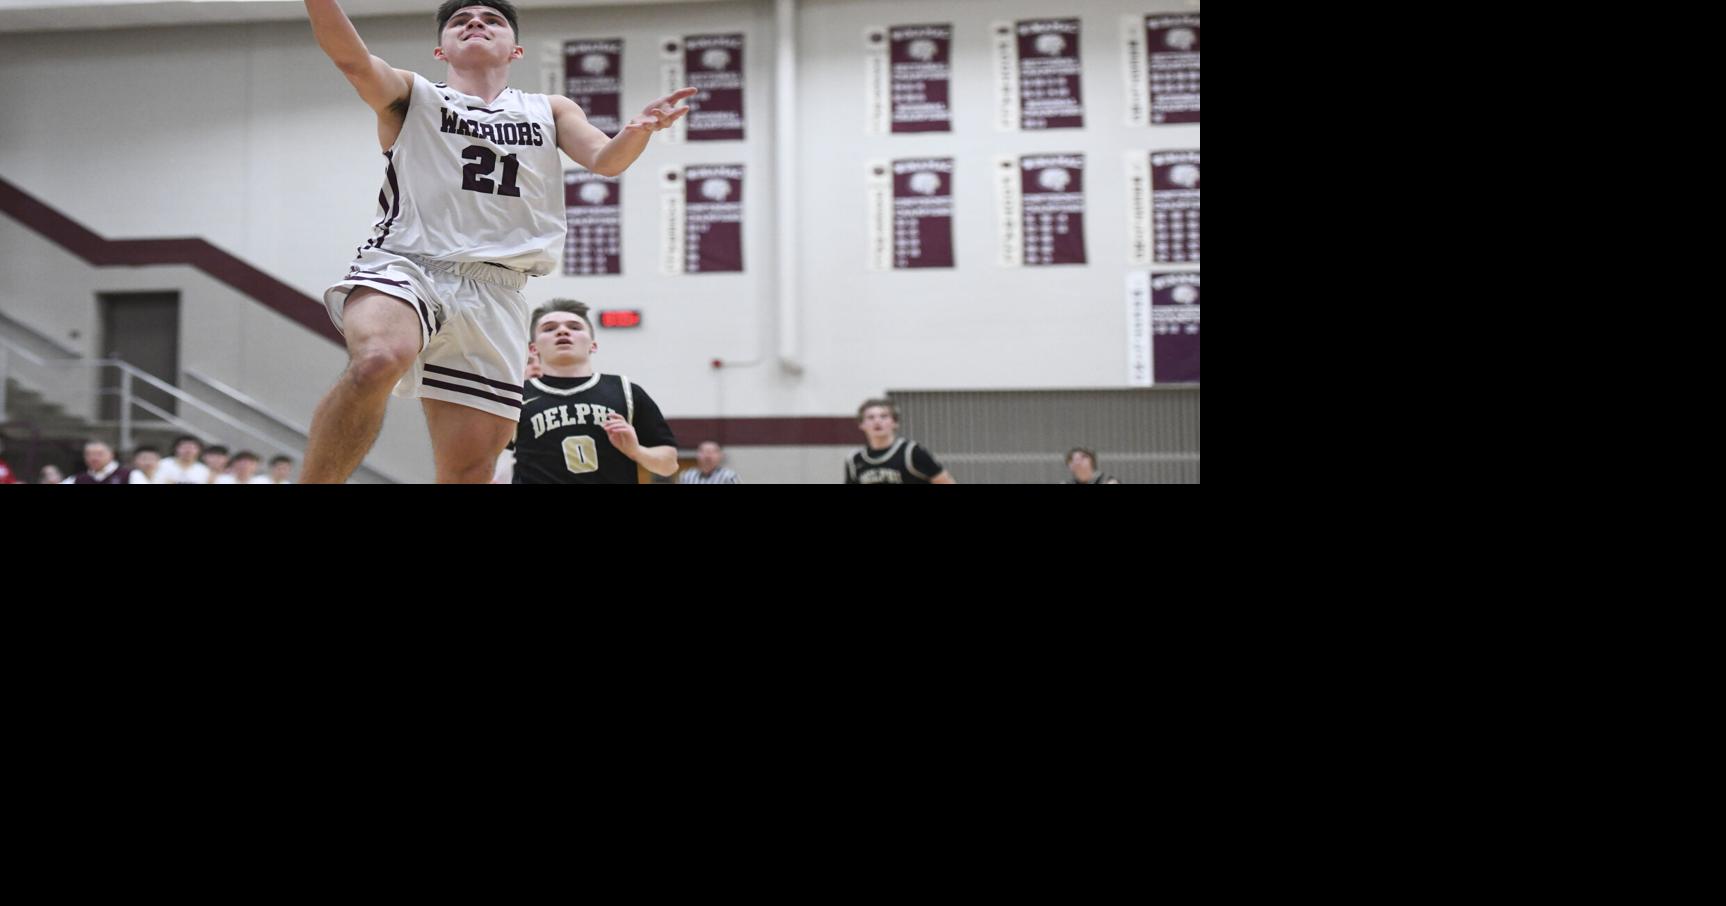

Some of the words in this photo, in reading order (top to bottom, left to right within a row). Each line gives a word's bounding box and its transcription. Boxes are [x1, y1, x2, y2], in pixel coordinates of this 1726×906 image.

[440, 106, 543, 146] WARRIORS
[461, 145, 520, 197] 21
[530, 403, 617, 439] DELPH
[562, 435, 599, 474] 0
